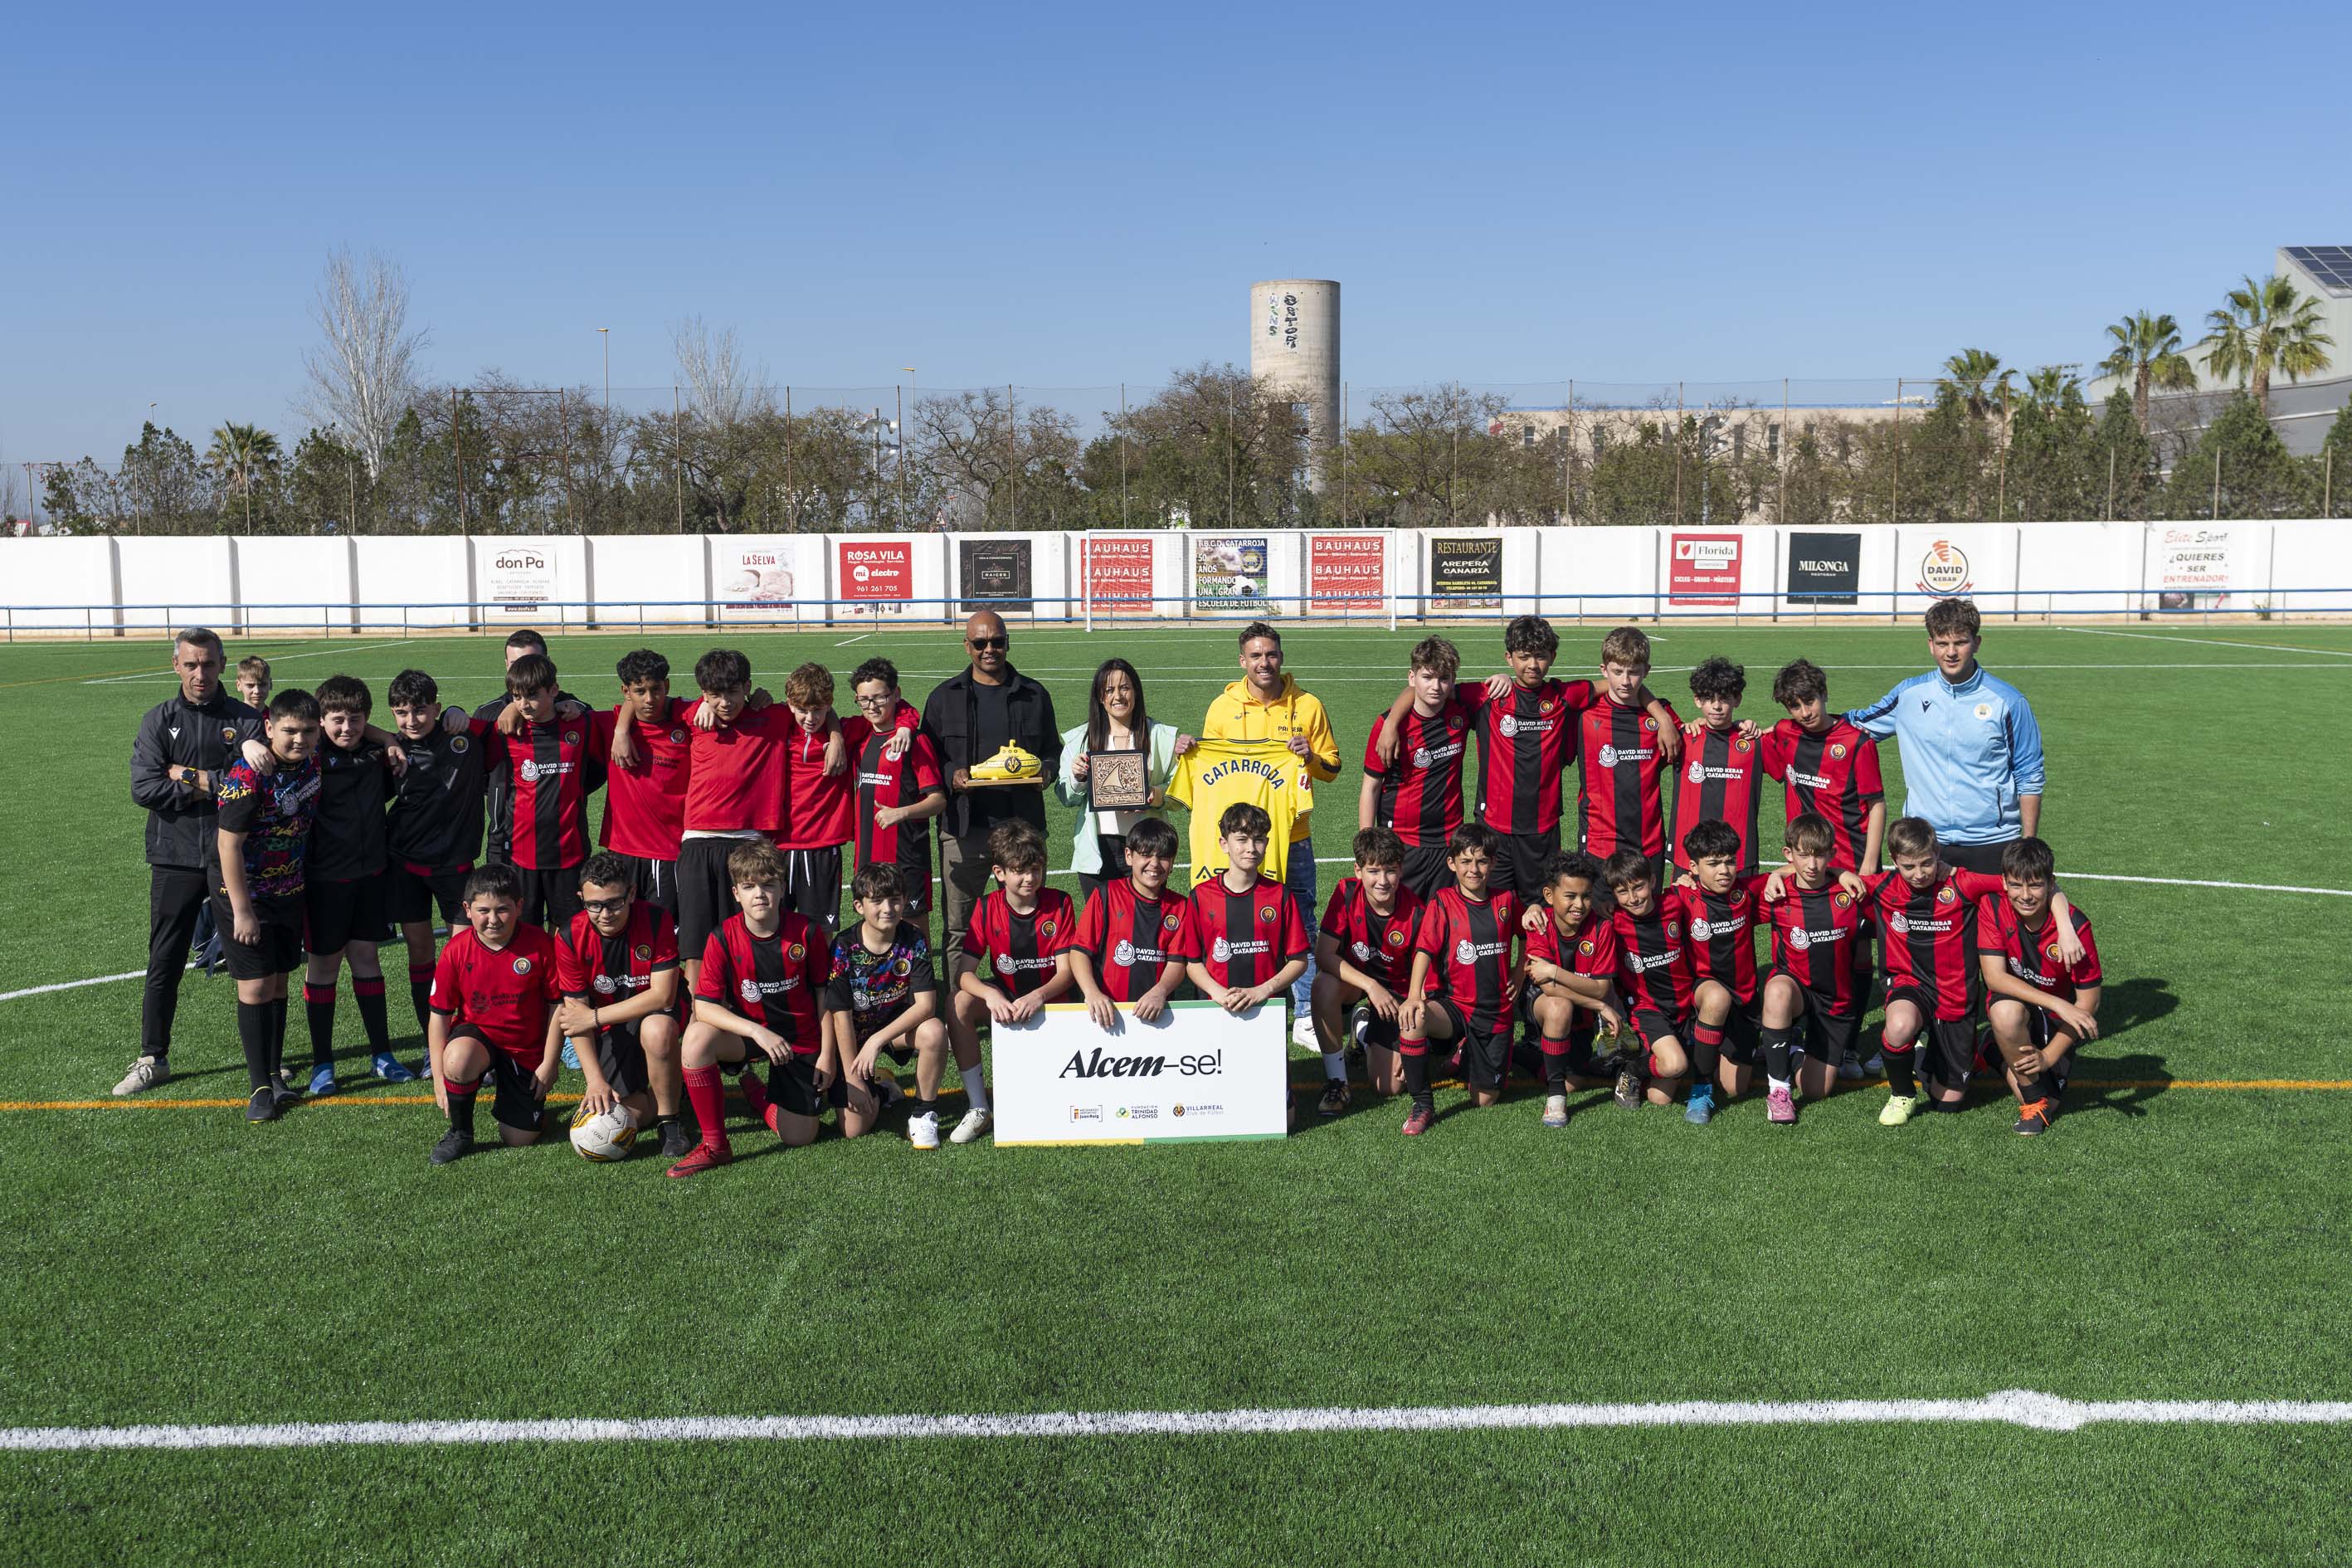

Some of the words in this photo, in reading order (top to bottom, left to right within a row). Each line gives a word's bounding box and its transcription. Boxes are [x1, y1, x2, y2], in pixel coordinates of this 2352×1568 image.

[1316, 541, 1381, 550] BAUHAUS
[1437, 542, 1497, 554] RESTAURANTE
[847, 551, 877, 560] ROSA
[879, 550, 904, 560] VILA
[1699, 546, 1733, 555] Florida
[1198, 553, 1207, 562] 50
[495, 557, 523, 569] don
[526, 557, 544, 569] Pa
[1799, 560, 1849, 572] MILONGA
[871, 568, 900, 577] electro
[1316, 565, 1380, 574] BAUHAUS
[1927, 566, 1963, 574] DAVID
[1198, 587, 1213, 596] UNA
[1430, 746, 1448, 755] DAVID
[1203, 758, 1285, 790] CATARROJA
[1811, 776, 1830, 784] KEBAB
[1643, 954, 1663, 963] DAVID
[629, 975, 650, 983] KEBAB
[870, 993, 890, 1001] DAVID
